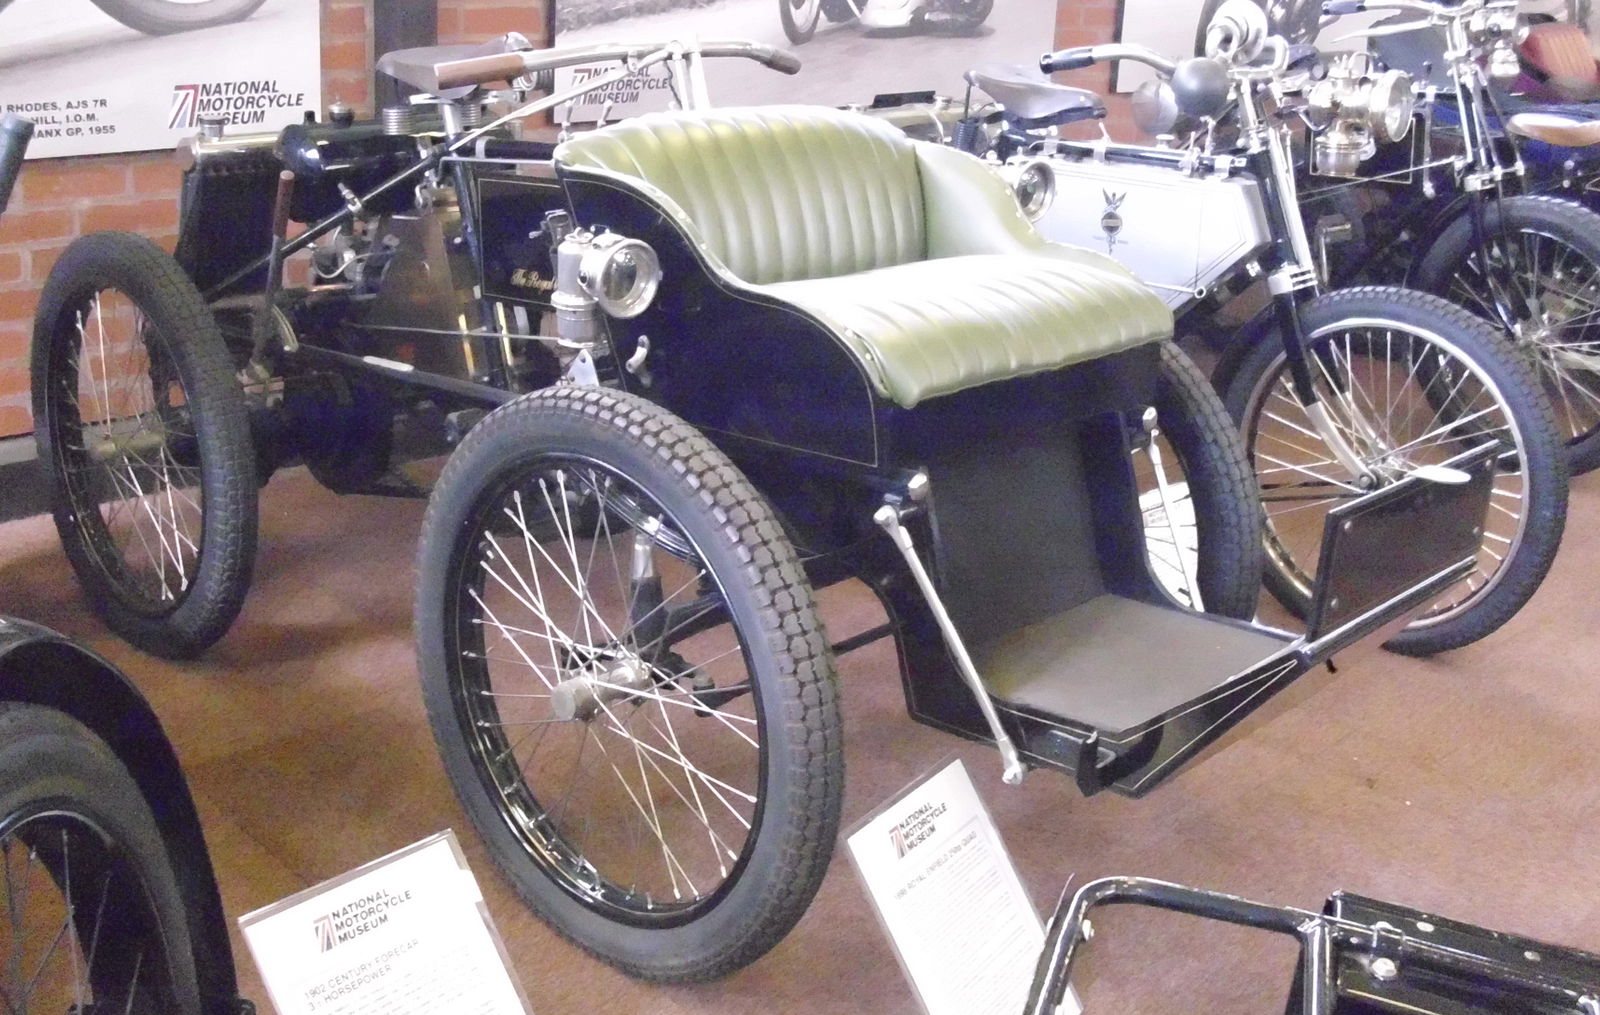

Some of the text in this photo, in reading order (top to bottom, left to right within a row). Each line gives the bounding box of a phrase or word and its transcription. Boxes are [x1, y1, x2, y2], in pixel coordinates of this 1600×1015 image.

[200, 80, 279, 97] NATIONAL
[592, 79, 668, 92] OTORCYCLE
[7, 102, 61, 114] RHODES,
[66, 100, 89, 110] AJS
[93, 99, 108, 108] 7R
[197, 93, 304, 112] MOTORCYCLE
[588, 92, 639, 105] MUSEUM
[66, 113, 99, 123] I.O.M.
[195, 110, 265, 127] SEUM
[32, 128, 62, 139] ANX
[89, 125, 116, 135] 1955
[899, 802, 933, 830] NATIONAL
[903, 802, 947, 840] MOTORCYCLE
[906, 823, 936, 850] MUSEUM
[332, 889, 389, 920] NATIONAL
[335, 890, 411, 932] MOTORCYCLE
[338, 914, 388, 944] MUSEUM
[324, 964, 393, 1003] HORSEPOWER
